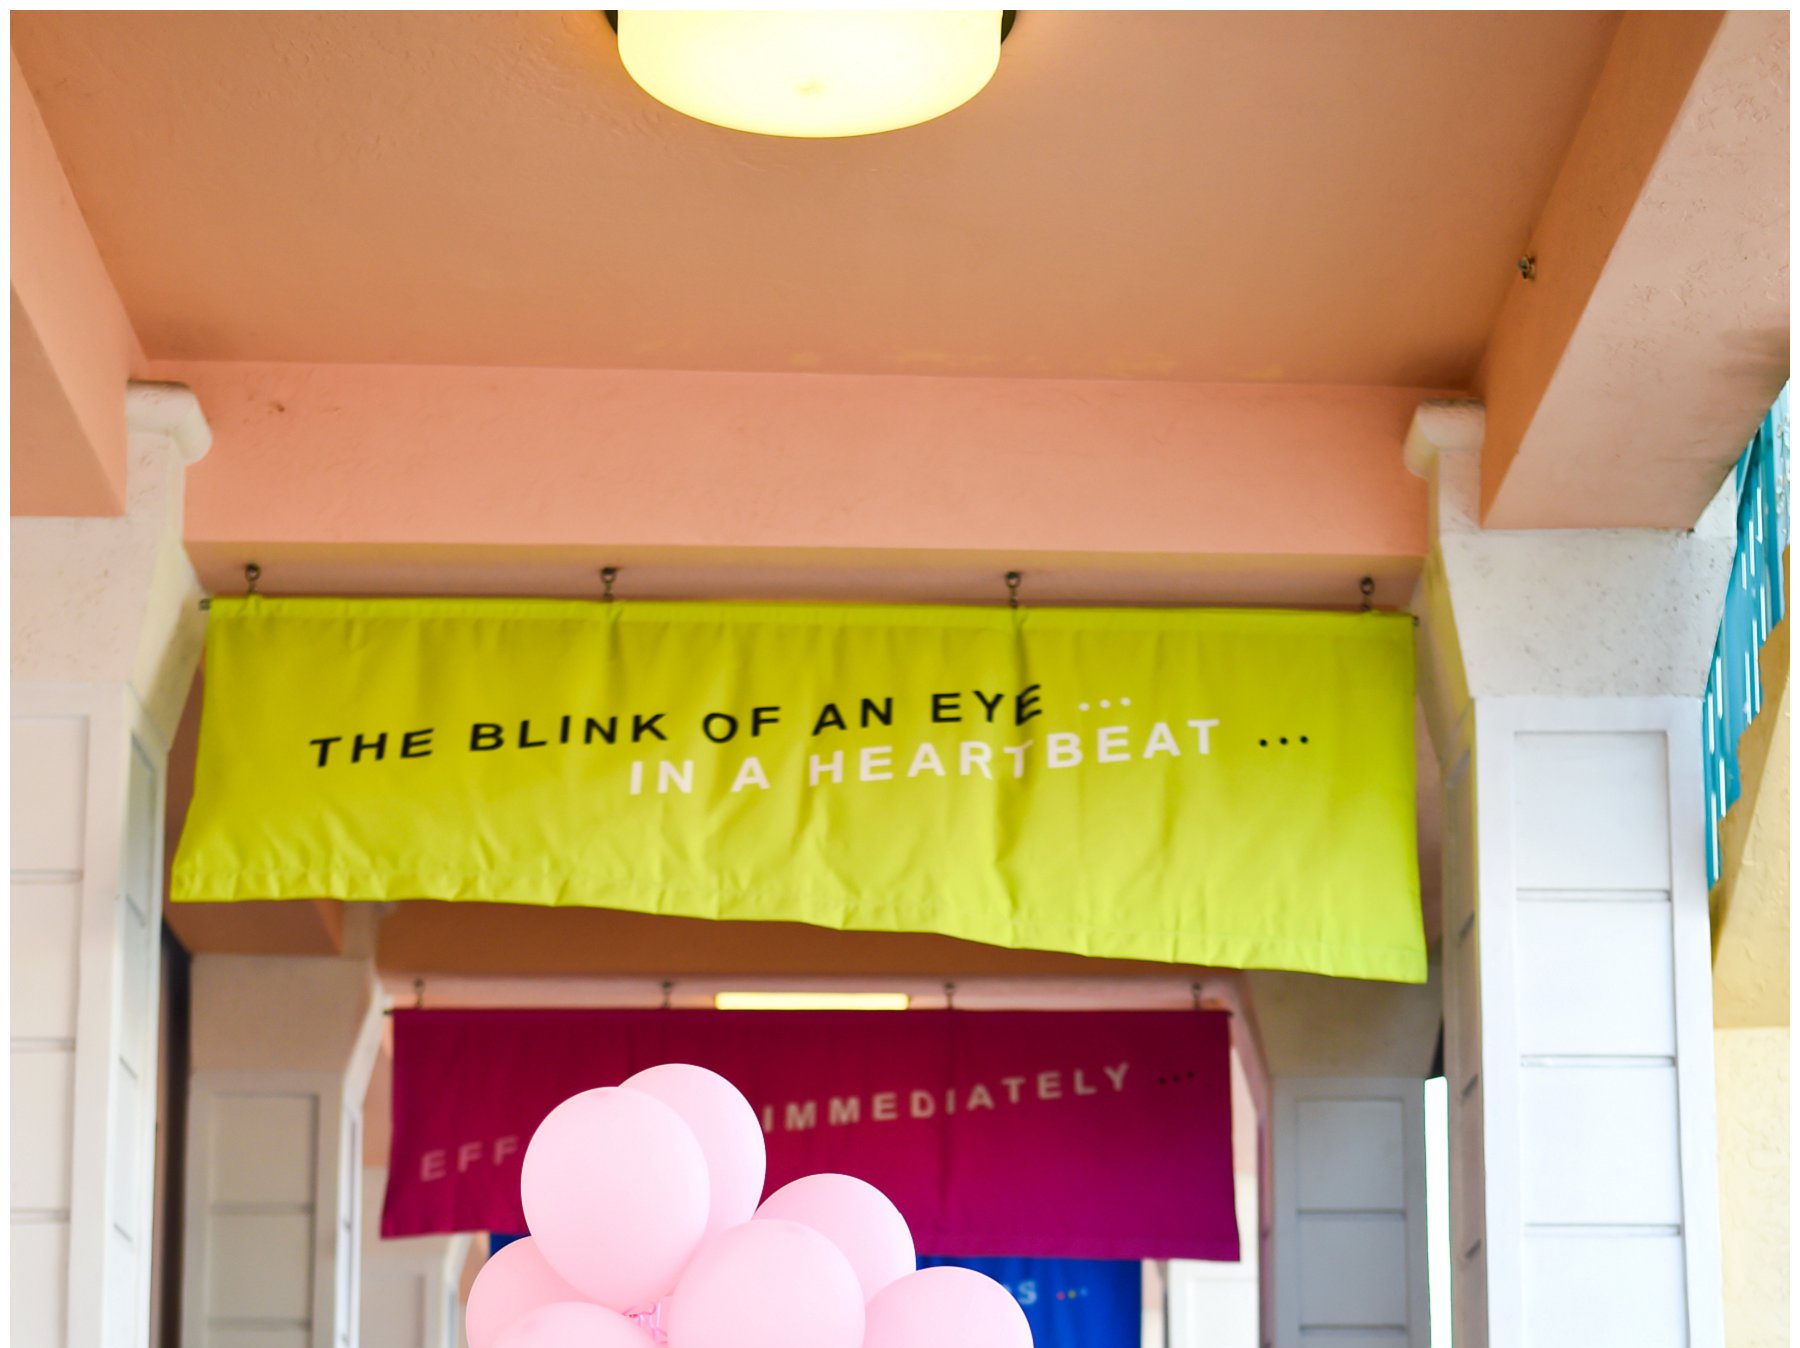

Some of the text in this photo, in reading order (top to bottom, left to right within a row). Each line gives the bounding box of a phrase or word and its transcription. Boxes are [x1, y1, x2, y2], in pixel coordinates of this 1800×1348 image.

[309, 728, 435, 768] THE
[469, 712, 669, 752] BLINK
[702, 706, 781, 744] OF
[812, 696, 894, 737] AN
[930, 683, 1043, 727] EYE
[629, 759, 694, 796] IN
[730, 755, 771, 793] A
[808, 718, 1221, 787] HEARTBEAT
[420, 1135, 518, 1182] EFF
[763, 1062, 1130, 1134] IMMEDIATELY
